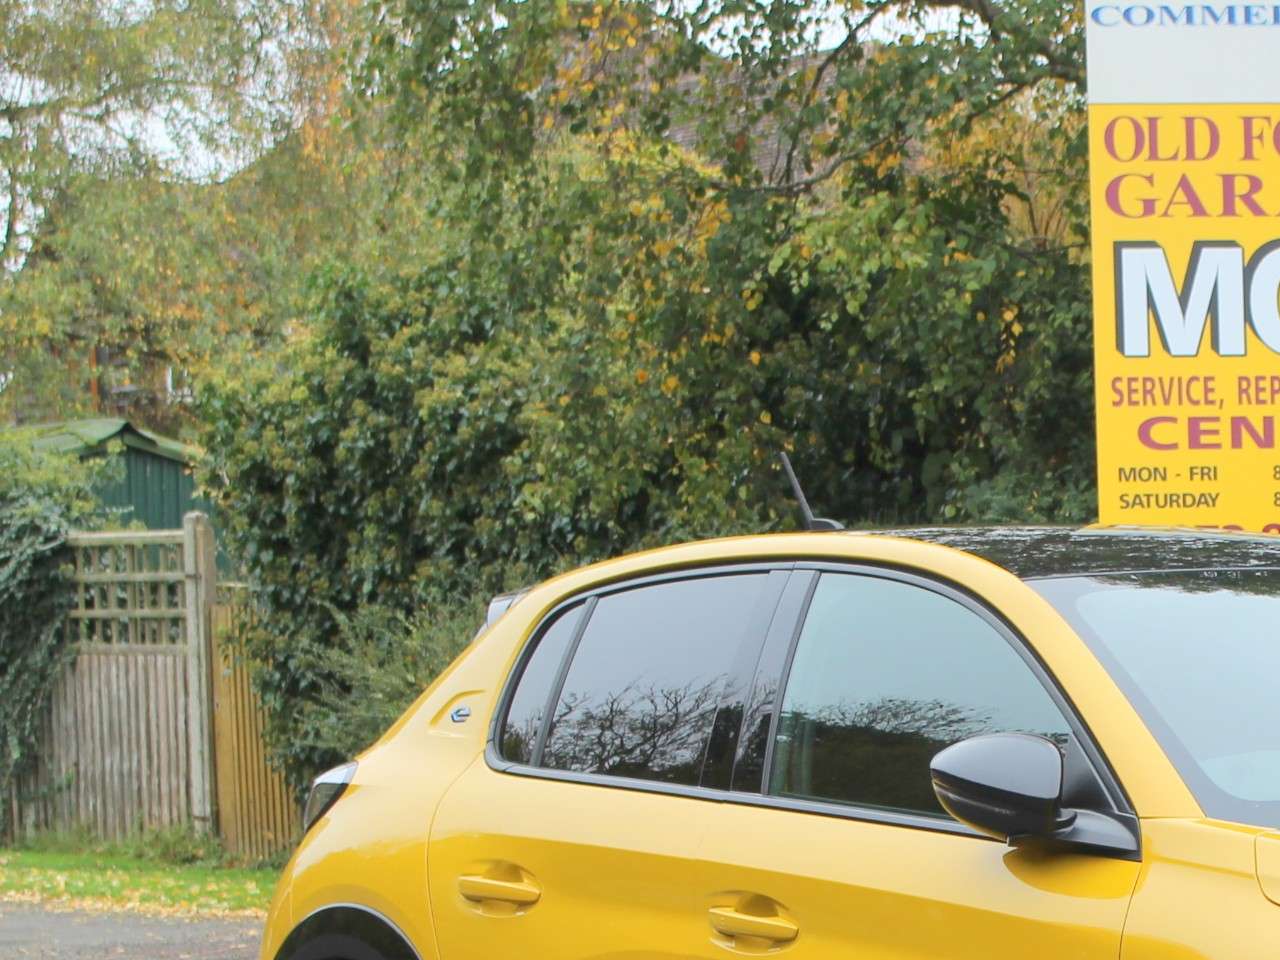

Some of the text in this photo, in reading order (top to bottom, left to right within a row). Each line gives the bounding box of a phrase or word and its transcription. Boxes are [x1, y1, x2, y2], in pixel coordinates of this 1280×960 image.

[1104, 115, 1220, 163] OLD
[1111, 375, 1224, 410] SERVICE,
[1118, 466, 1168, 483] MON
[1189, 466, 1218, 482] FRI
[1119, 492, 1220, 510] SATURDAY
